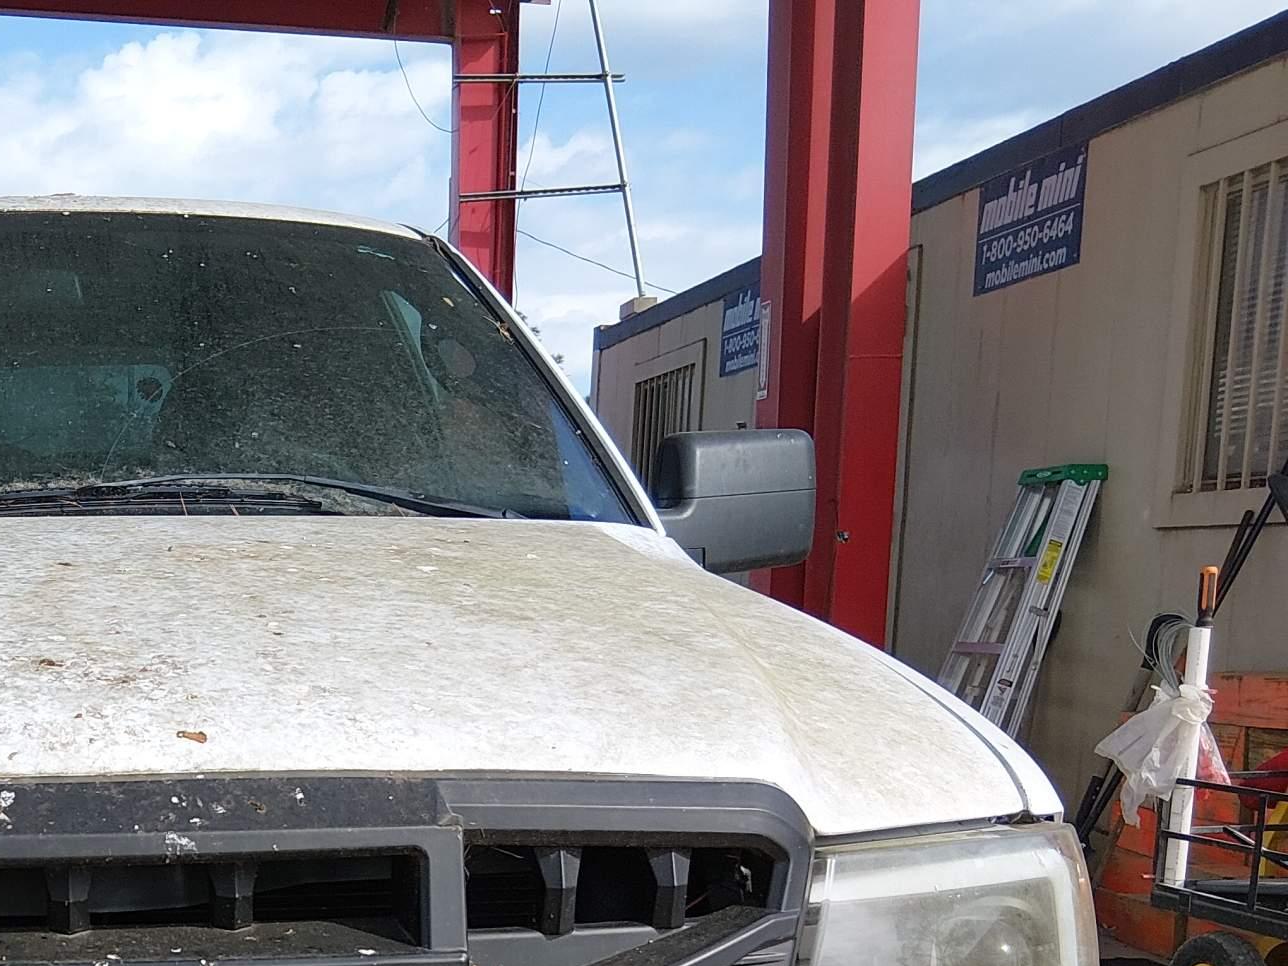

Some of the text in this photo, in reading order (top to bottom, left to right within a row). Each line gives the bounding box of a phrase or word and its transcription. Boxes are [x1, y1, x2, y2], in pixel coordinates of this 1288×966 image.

[980, 156, 1084, 233] mobile mini
[982, 212, 1074, 264] 1-800-950-6464
[985, 247, 1066, 288] mobilemini.com
